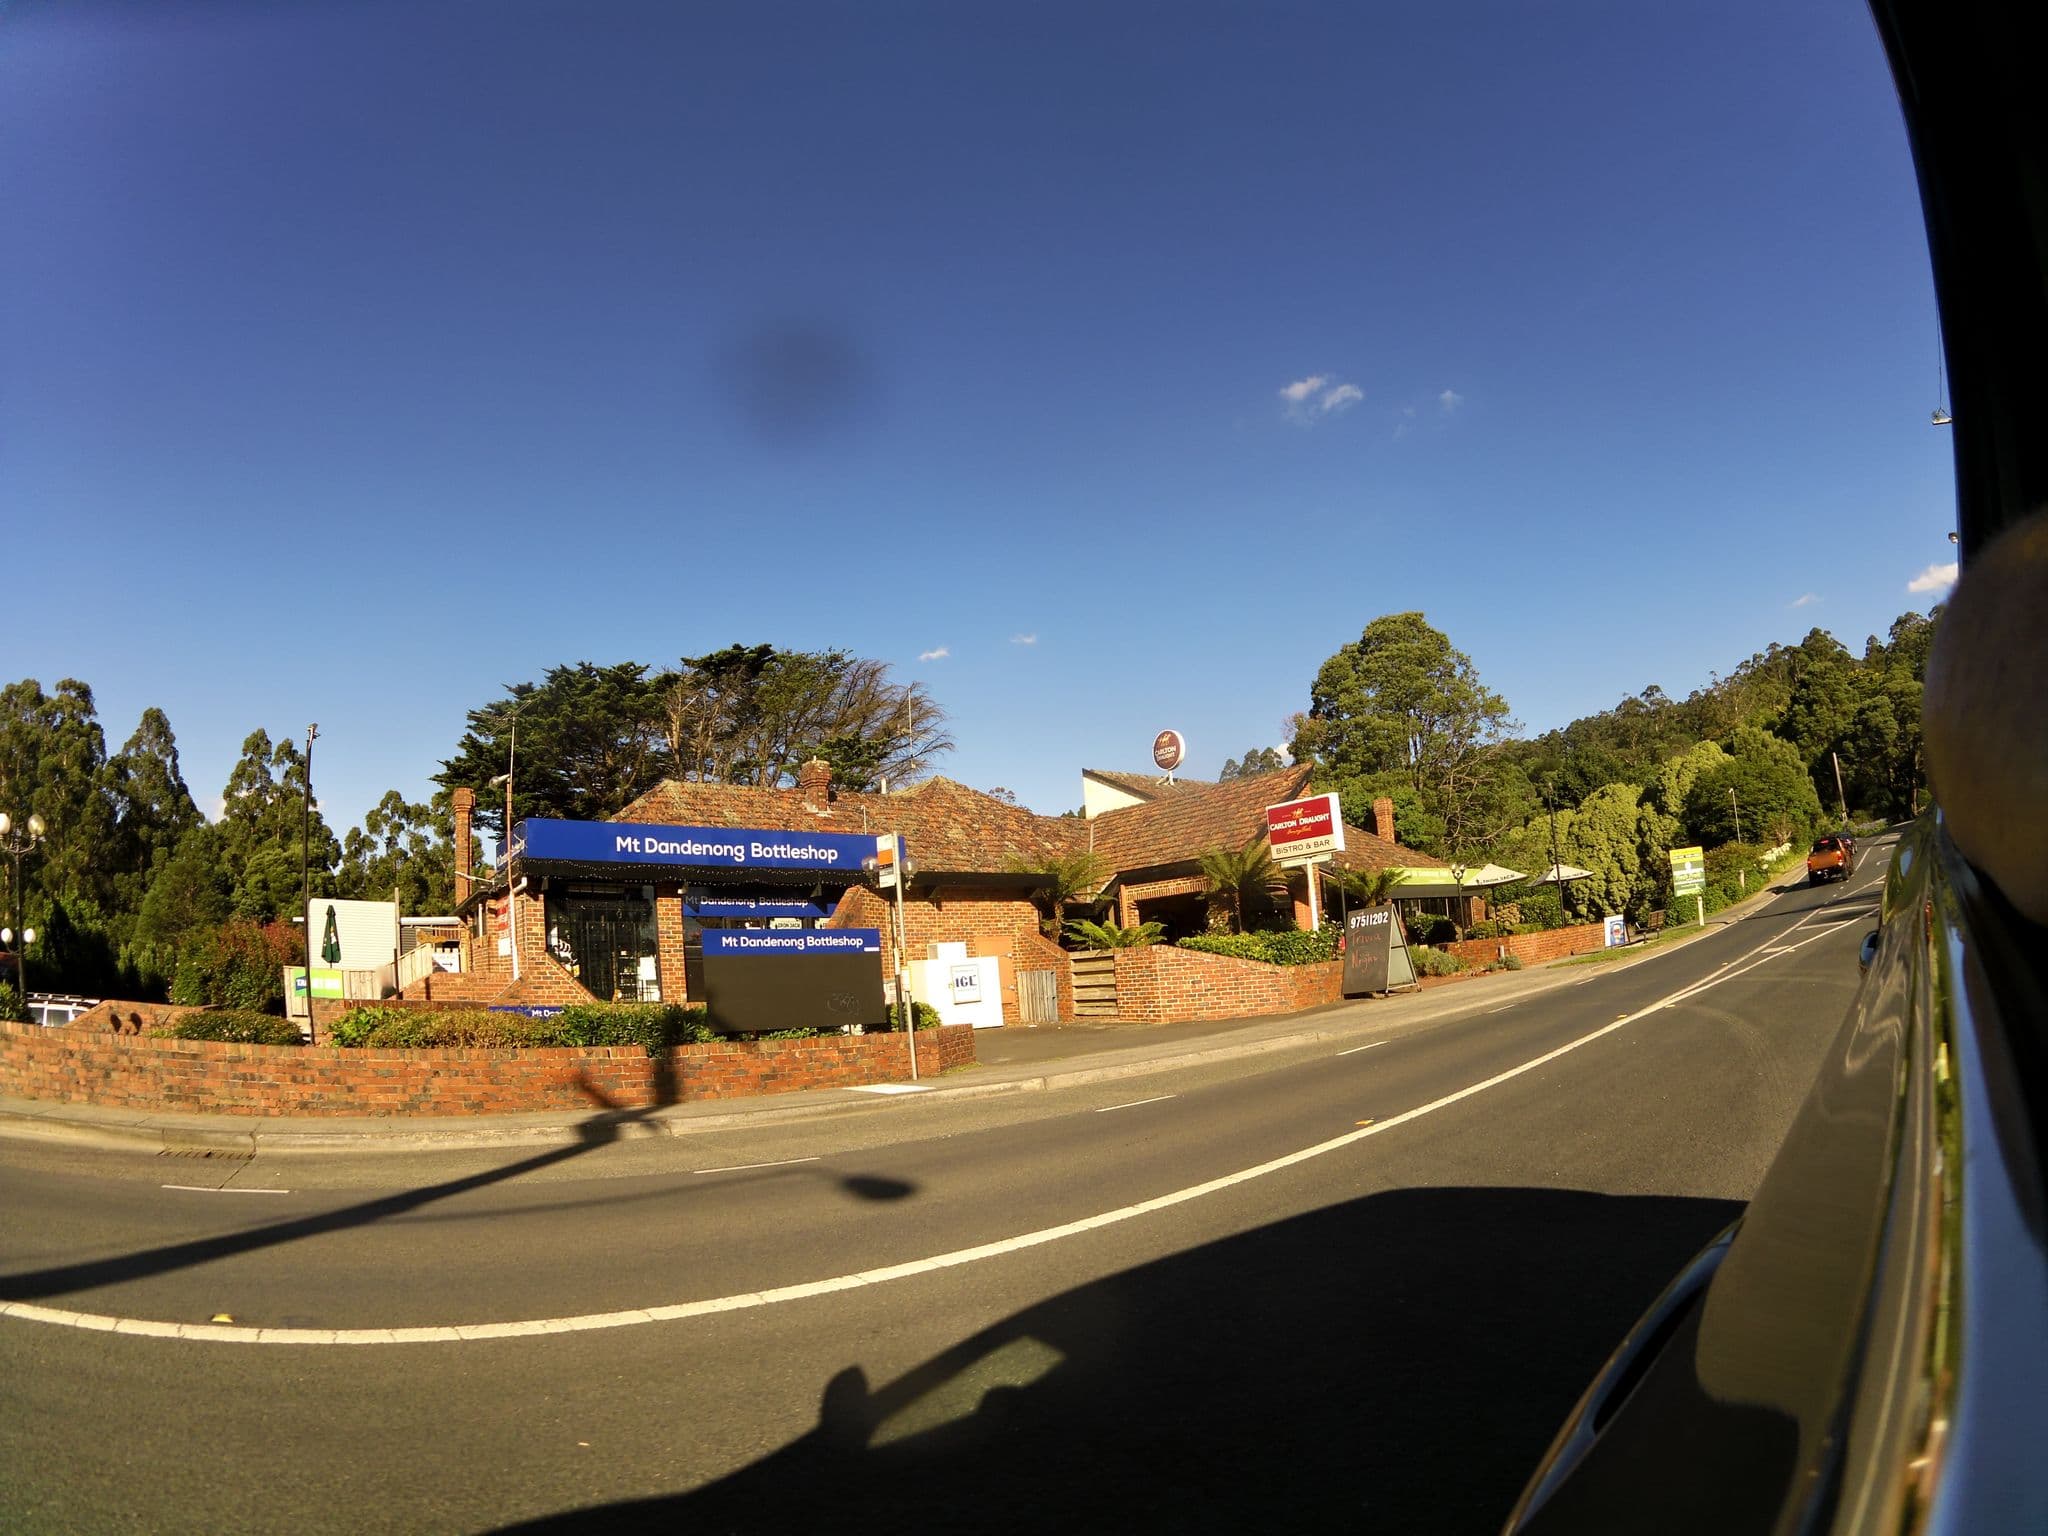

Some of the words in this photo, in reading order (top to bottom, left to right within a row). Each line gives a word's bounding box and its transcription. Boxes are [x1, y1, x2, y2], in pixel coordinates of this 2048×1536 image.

[1270, 820, 1297, 831] CARLTON
[1299, 813, 1330, 825] DRAUGHT
[616, 837, 641, 853] Mt
[644, 837, 746, 863] Dandenong
[750, 842, 839, 865] Bottleshop
[1314, 840, 1330, 848] BAR
[685, 896, 699, 905] Mt
[700, 896, 756, 909] Dandenong
[758, 897, 809, 908] Bottleshop
[1350, 912, 1388, 928] 97511202
[721, 936, 739, 948] Mt
[740, 936, 805, 951] Dandenong
[806, 936, 864, 949] Bottleshop
